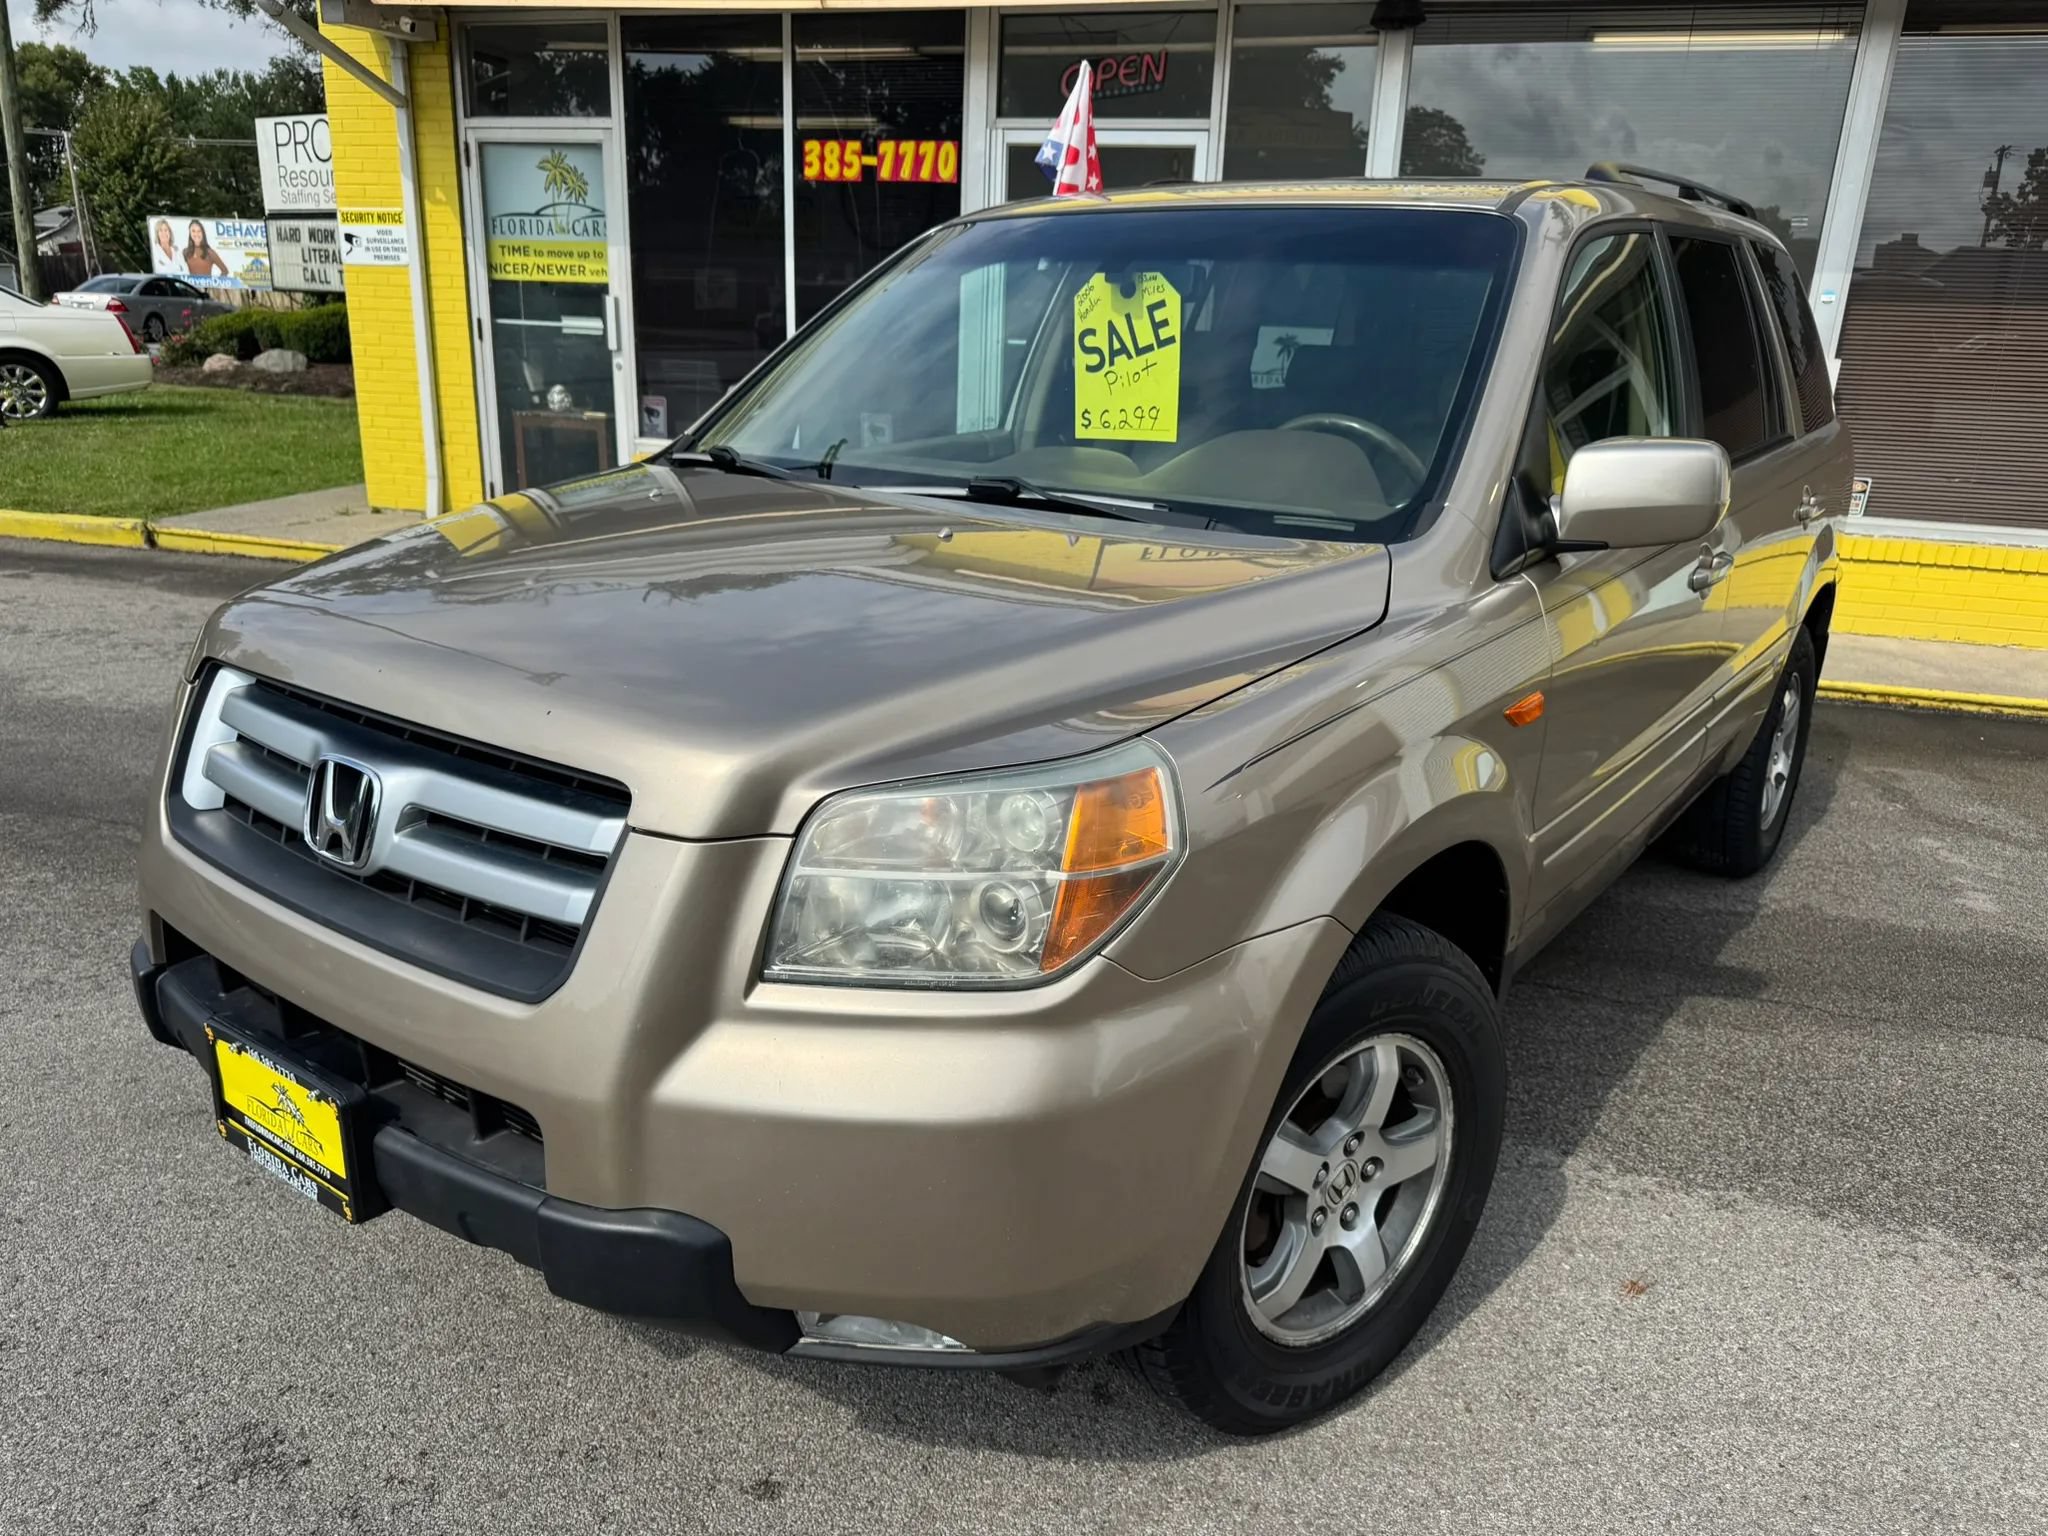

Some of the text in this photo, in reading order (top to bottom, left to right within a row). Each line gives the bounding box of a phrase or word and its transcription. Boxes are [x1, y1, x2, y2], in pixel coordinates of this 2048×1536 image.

[1061, 48, 1167, 98] OPEN
[803, 140, 957, 181] 385-7770
[280, 189, 321, 207] Staffing
[341, 211, 403, 224] SECURITY NOTICE
[491, 217, 555, 236] FLORIDA
[276, 226, 336, 244] HARD WORK
[366, 237, 405, 245] SURVEILLANCE
[373, 254, 401, 262] PREMISES
[498, 244, 604, 261] TIME to move up to
[303, 268, 331, 285] CALL
[489, 262, 586, 278] NICER/NEWER
[1078, 298, 1177, 374] SALE
[1103, 358, 1158, 396] Pilot
[246, 1097, 321, 1156] FLORIDA CARS
[247, 1136, 318, 1193] FLORIDA CARS
